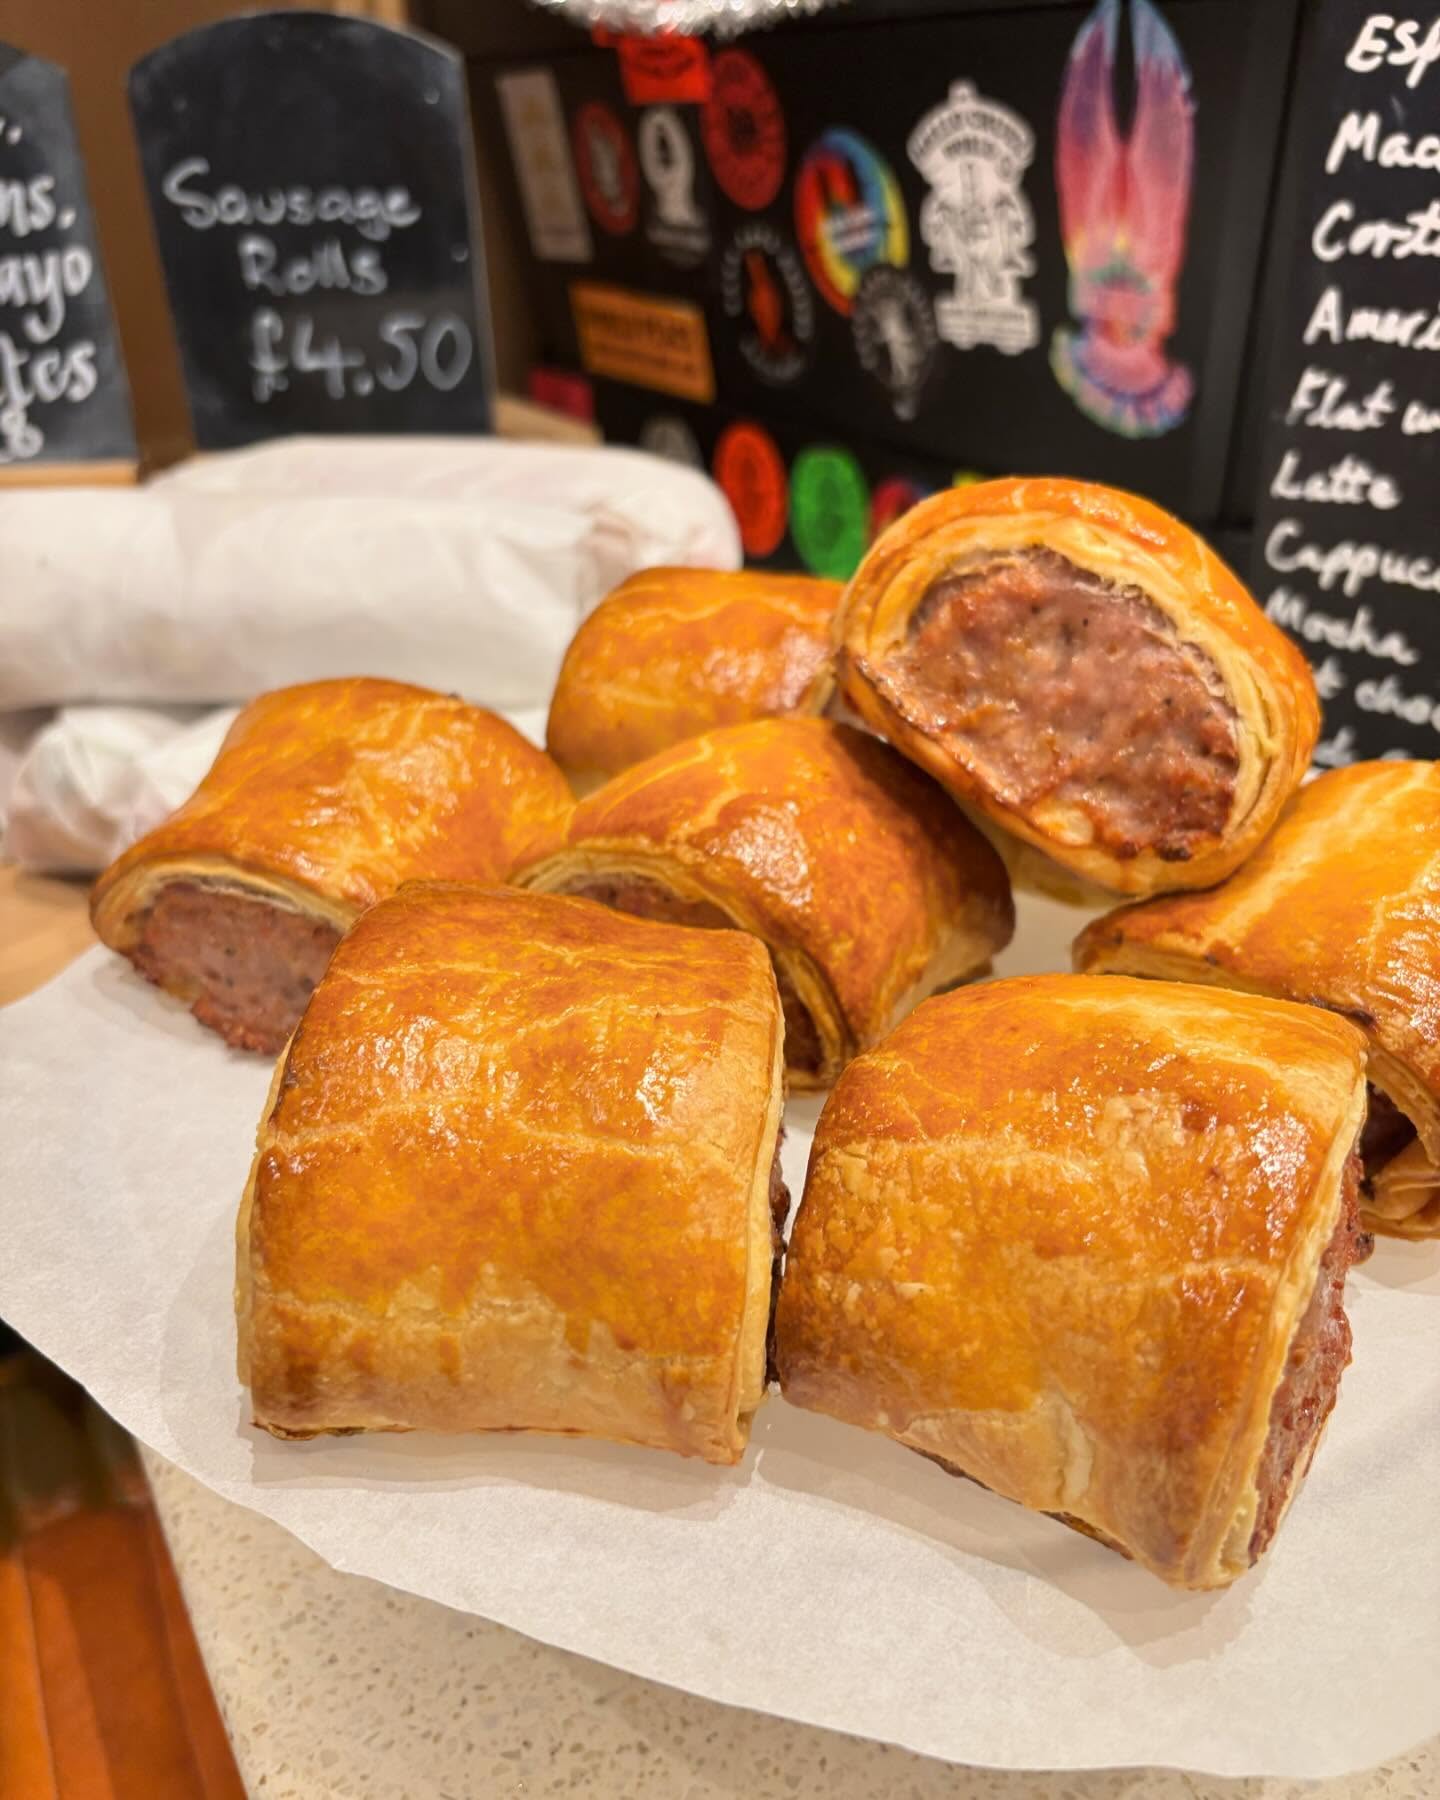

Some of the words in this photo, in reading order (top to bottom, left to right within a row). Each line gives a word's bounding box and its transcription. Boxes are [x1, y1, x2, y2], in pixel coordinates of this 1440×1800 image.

[163, 157, 421, 241] Sausage
[238, 235, 388, 296] Rolls
[250, 306, 472, 401] £4.50
[1286, 366, 1395, 430] Flat
[1270, 448, 1400, 510] Latte
[1264, 587, 1420, 666] Mocha
